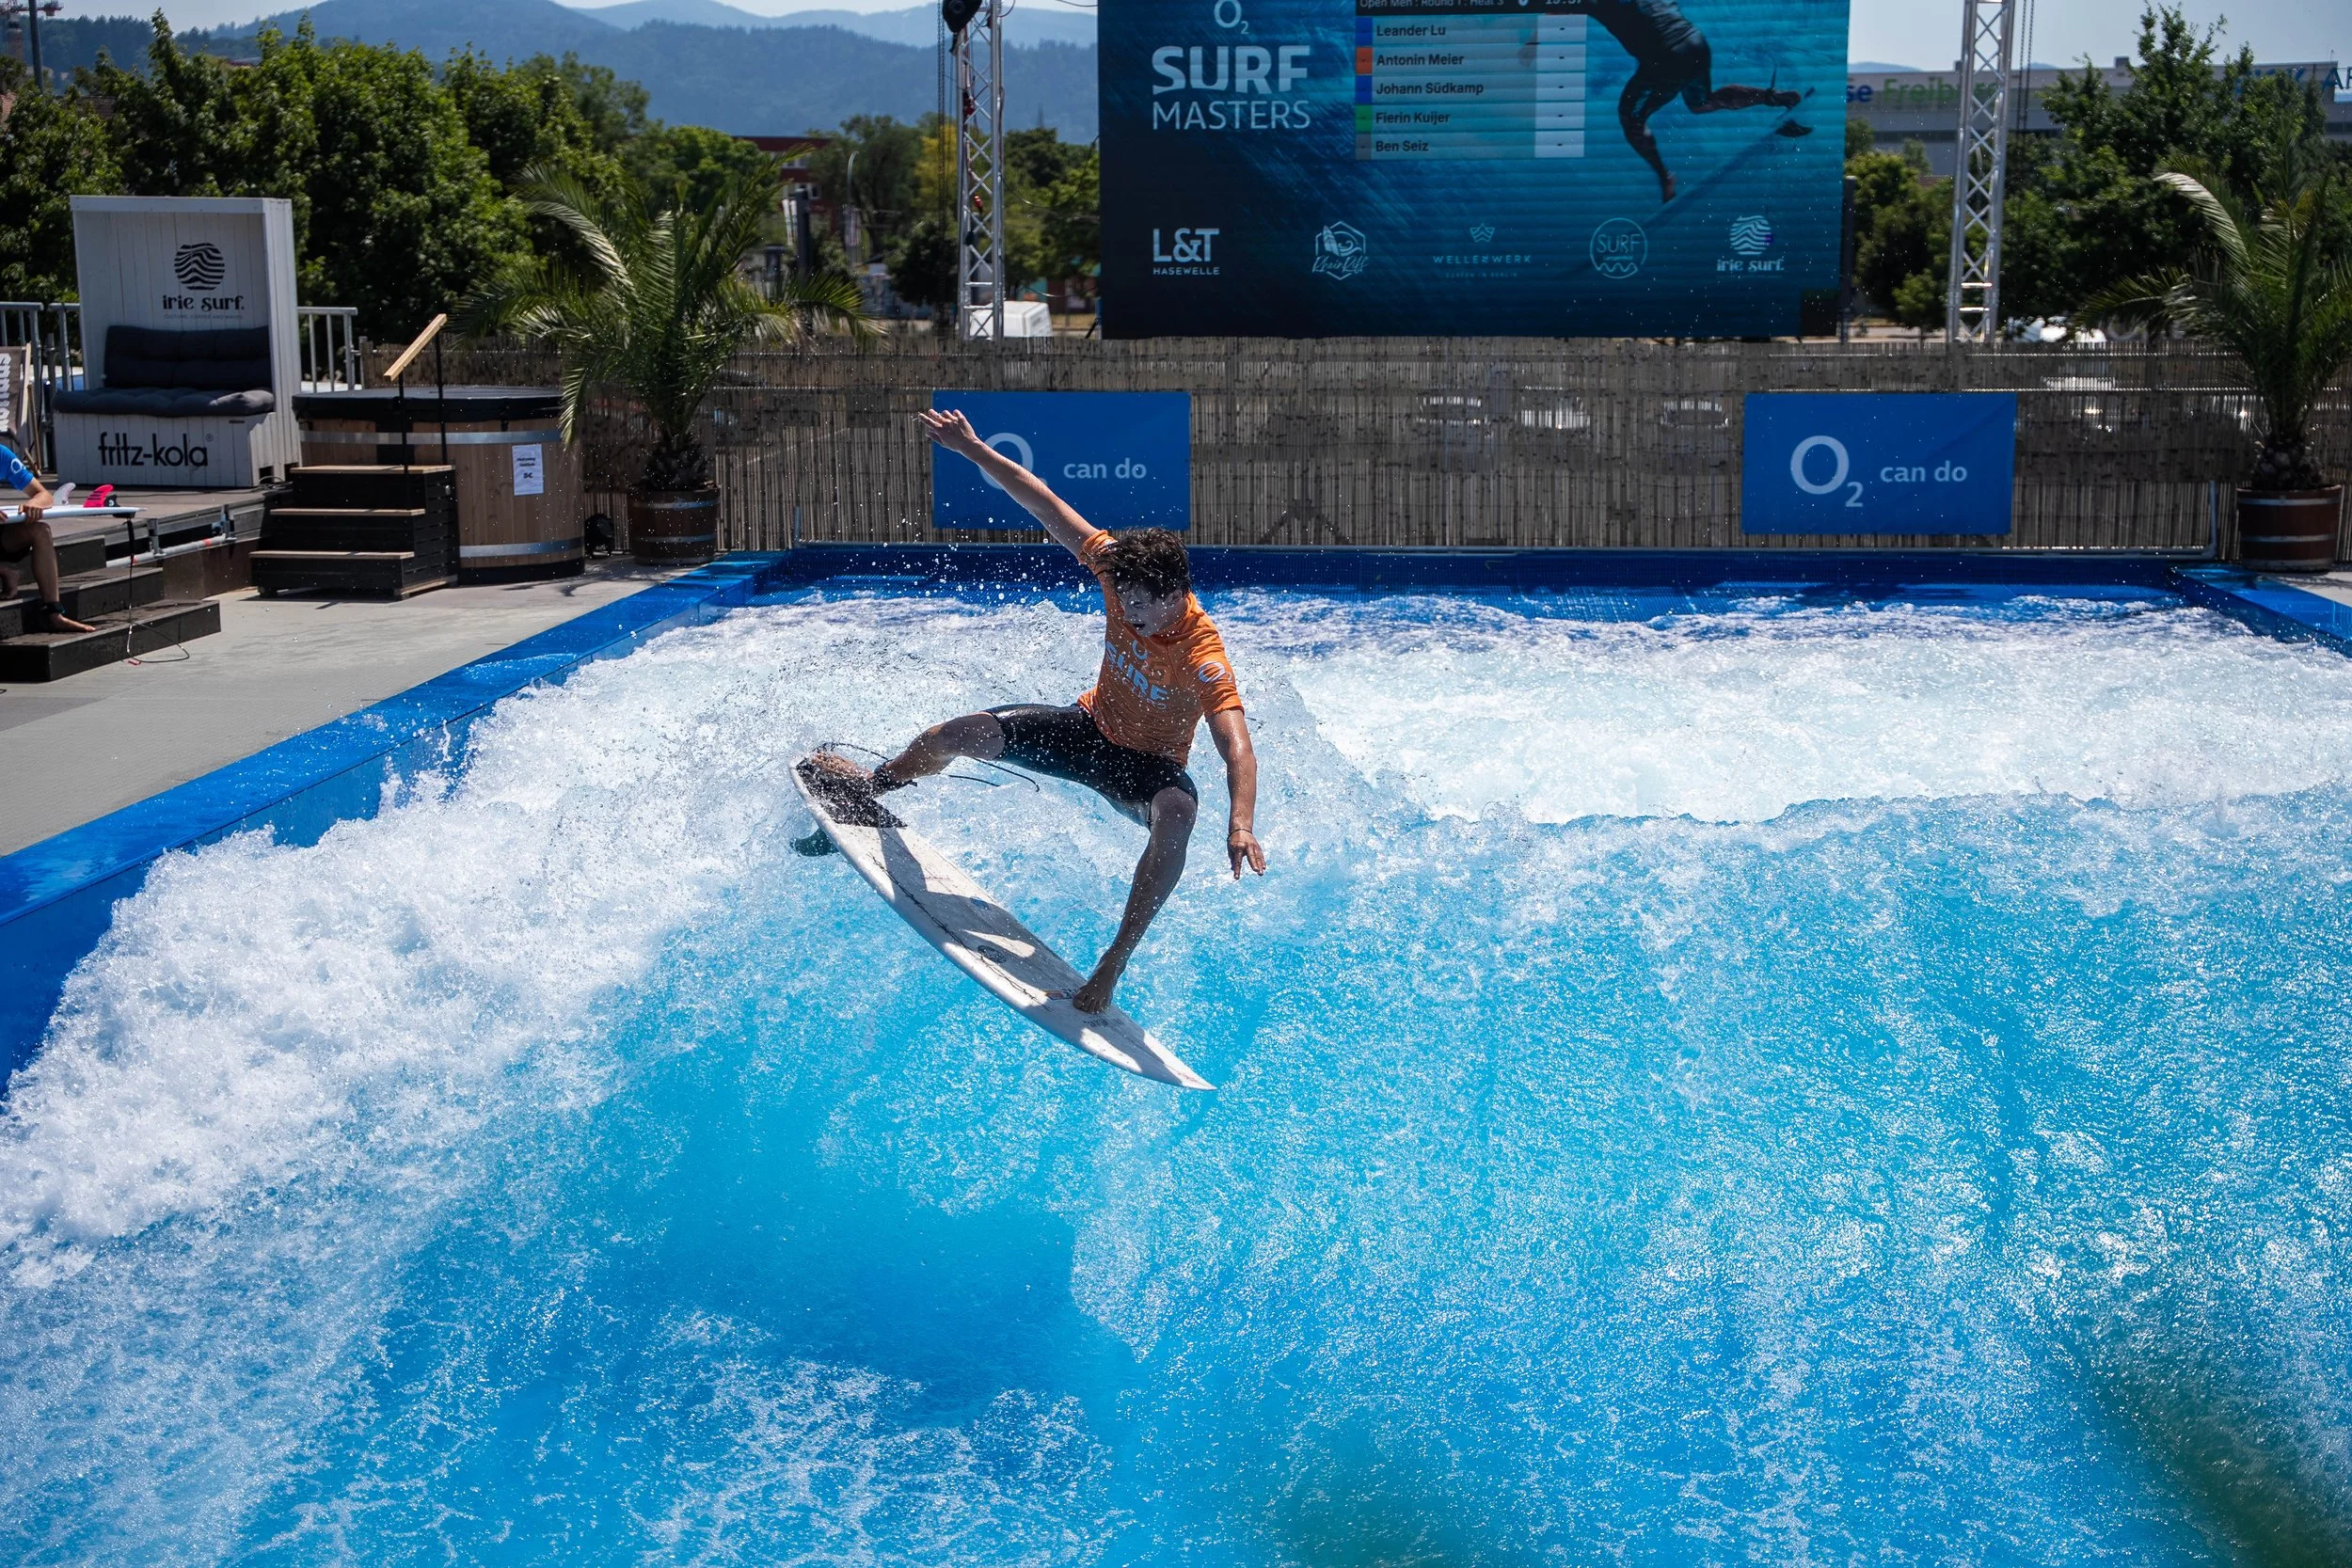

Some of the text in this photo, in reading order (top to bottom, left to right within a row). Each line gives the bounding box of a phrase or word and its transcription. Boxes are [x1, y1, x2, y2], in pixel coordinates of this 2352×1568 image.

[1376, 24, 1445, 36] Leander Lu
[1376, 54, 1464, 66] Antonin Meier
[1152, 45, 1311, 95] SURF
[1375, 82, 1484, 96] Johann Südkamp
[1152, 100, 1311, 130] MASTERS
[1413, 112, 1450, 126] Kuijer
[1375, 141, 1428, 151] Ben Seiz
[1153, 228, 1220, 262] L&T
[1597, 233, 1641, 253] SURF
[1432, 255, 1532, 264] WELLENWERK
[1716, 260, 1743, 272] irie
[163, 294, 194, 309] irie
[1063, 462, 1107, 480] can
[1114, 457, 1147, 480] do
[1880, 466, 1926, 483] can
[1934, 460, 1968, 483] do
[1105, 641, 1168, 701] SURF
